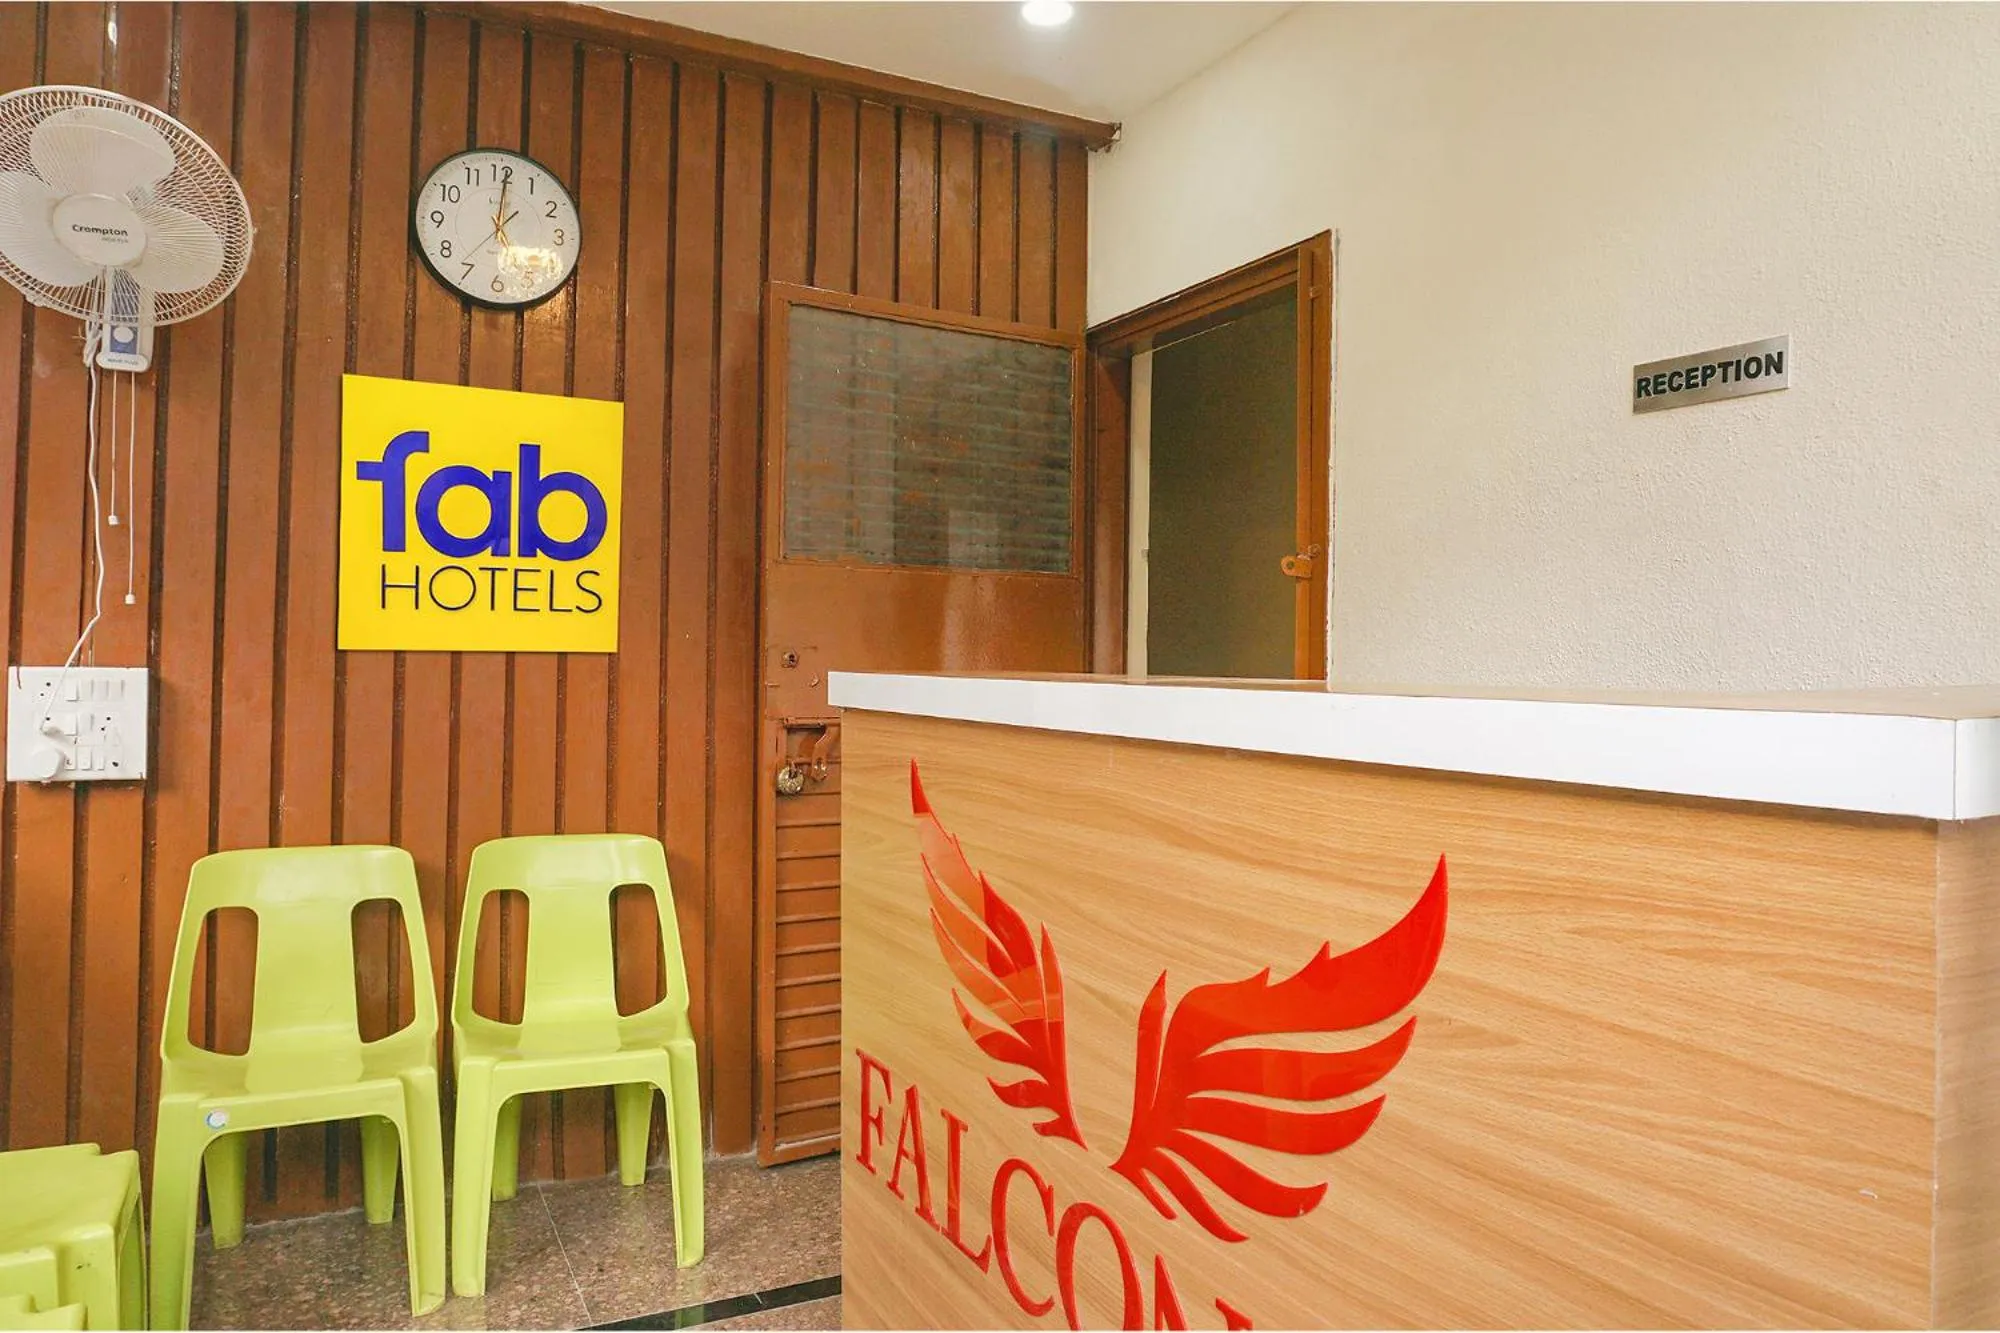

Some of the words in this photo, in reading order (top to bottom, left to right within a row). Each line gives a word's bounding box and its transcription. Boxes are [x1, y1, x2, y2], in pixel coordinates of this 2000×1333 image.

[464, 167, 480, 187] 11
[491, 163, 513, 185] 12
[440, 183, 461, 204] 10
[528, 177, 535, 195] 1
[544, 200, 558, 219] 2
[430, 210, 445, 229] 9
[72, 223, 128, 237] Crompton
[553, 228, 565, 246] 3
[440, 240, 452, 258] 8
[461, 262, 475, 281] 7
[520, 271, 534, 289] 5
[490, 275, 505, 293] 6
[1636, 351, 1784, 399] RECEPTION
[356, 431, 608, 562] fab
[381, 563, 603, 614] HOTELS
